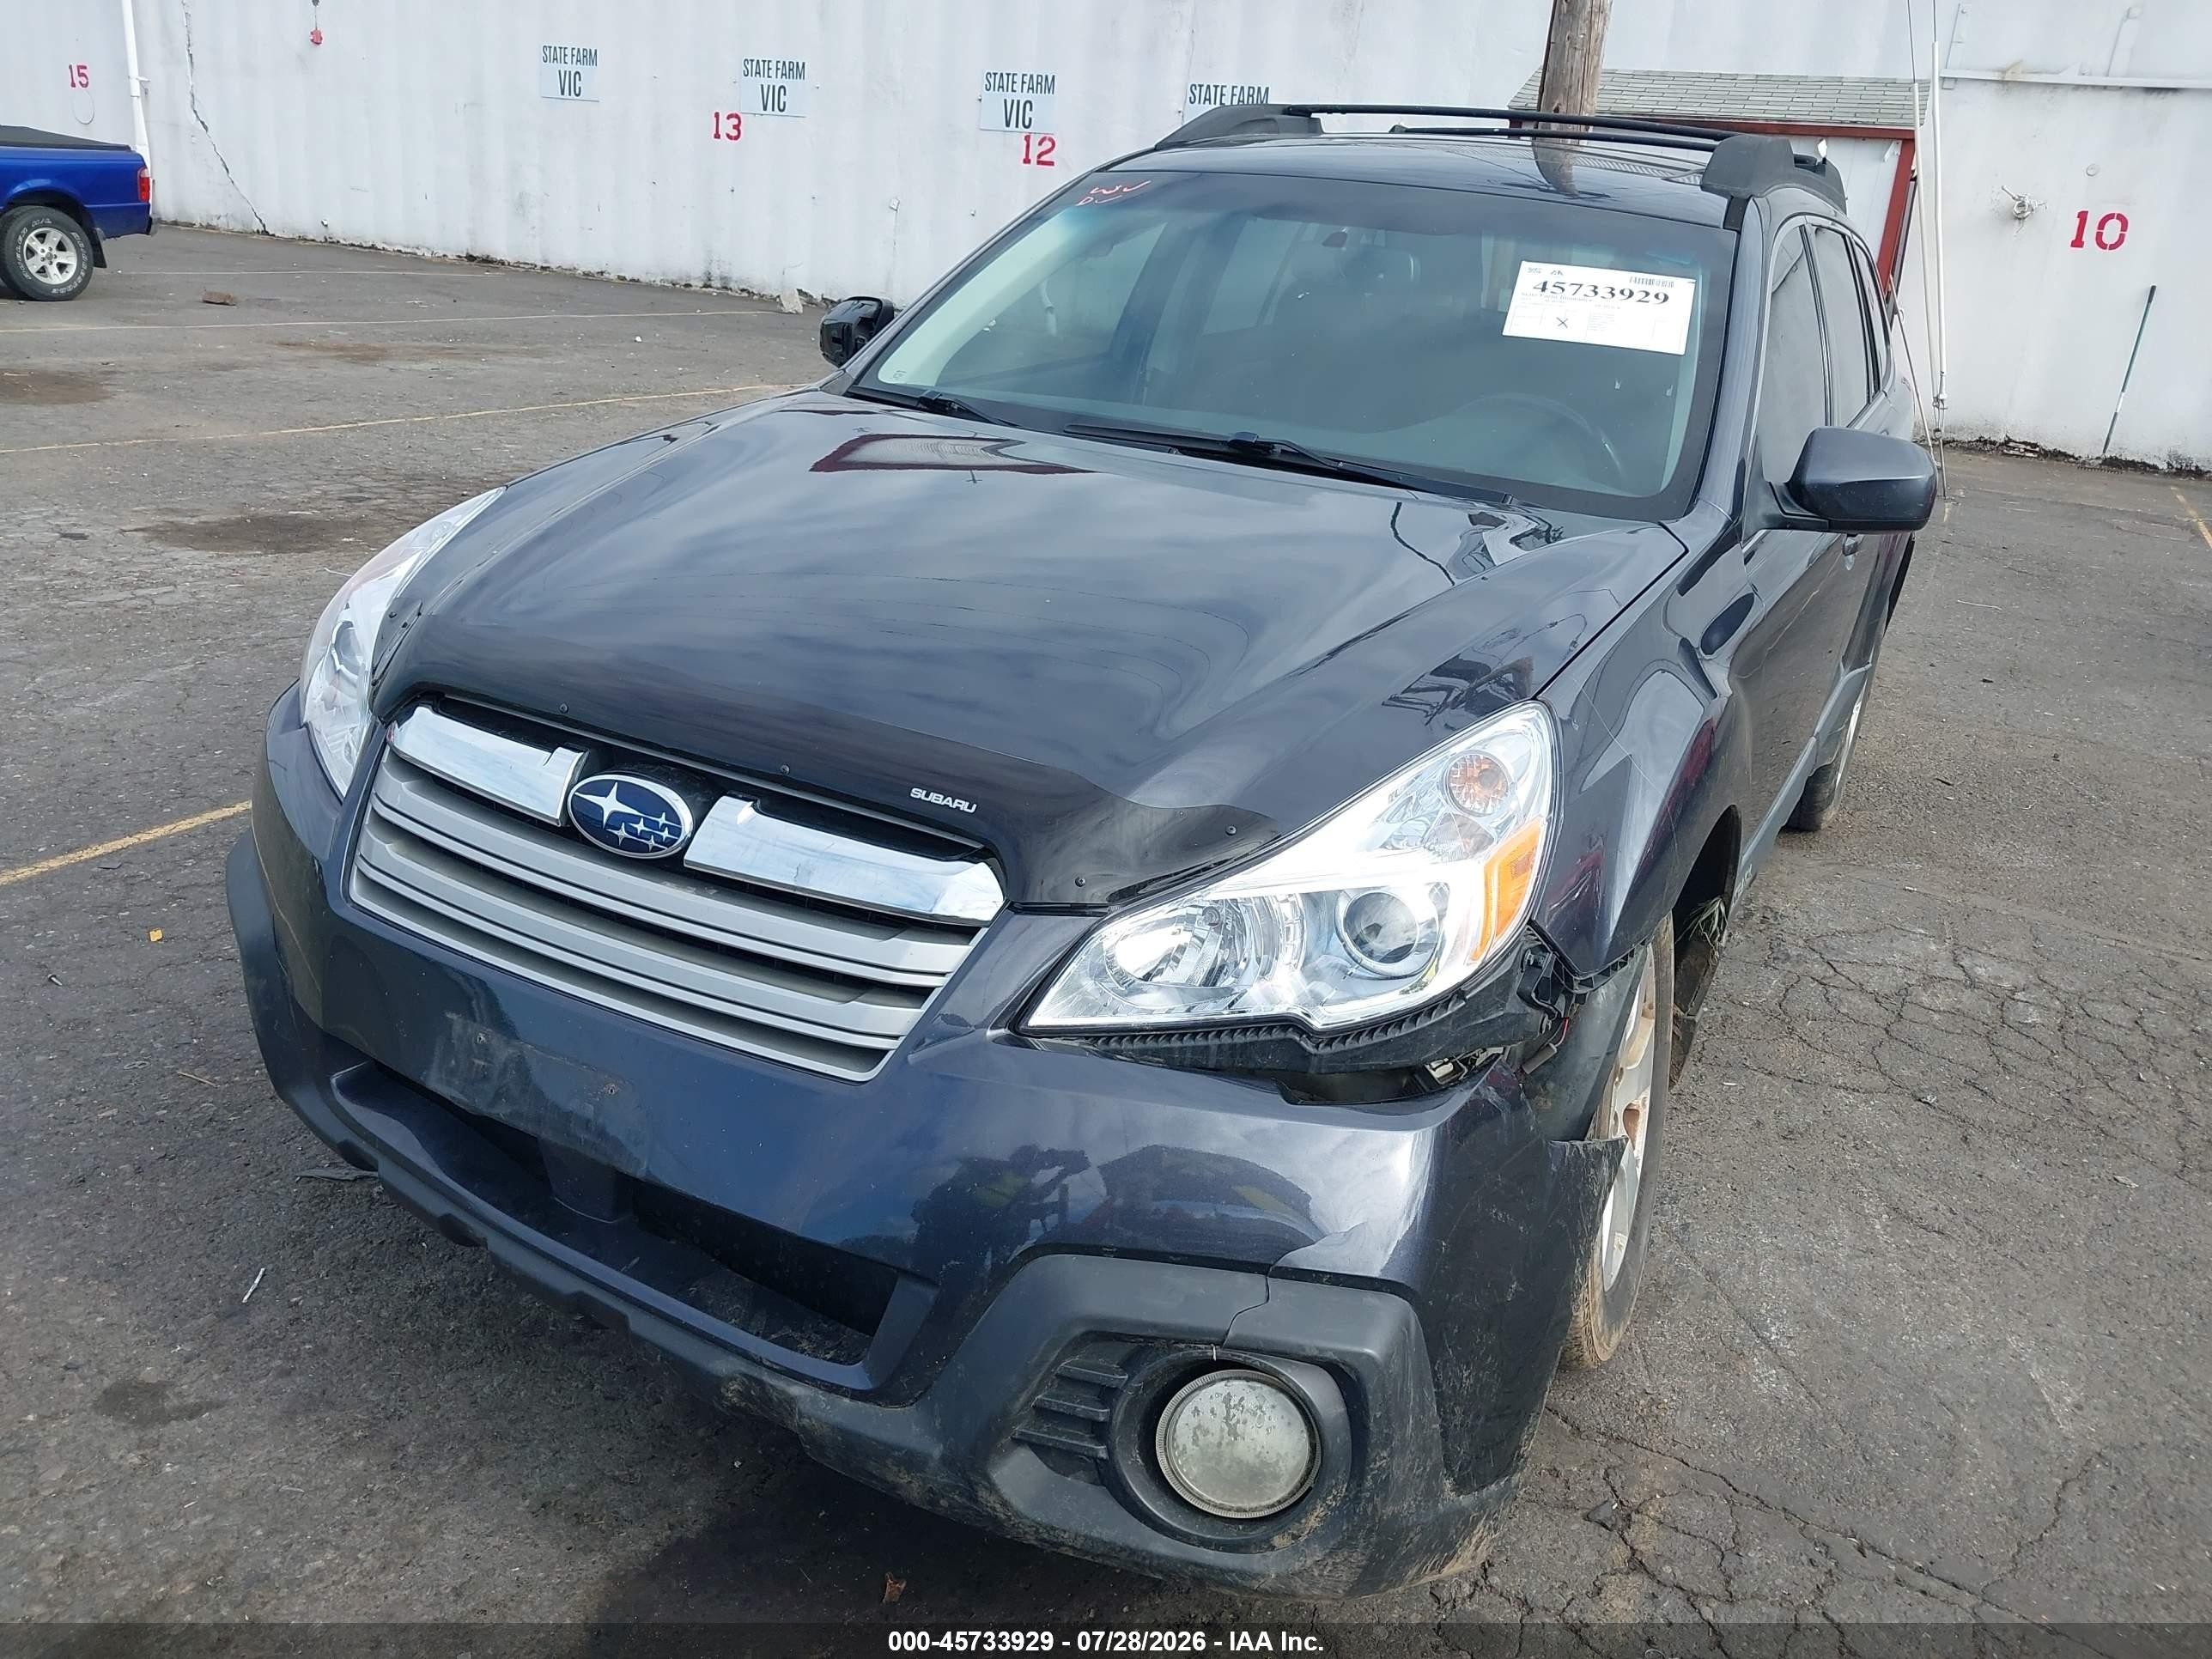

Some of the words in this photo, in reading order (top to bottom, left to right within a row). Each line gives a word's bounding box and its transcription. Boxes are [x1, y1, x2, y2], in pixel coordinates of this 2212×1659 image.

[542, 45, 568, 64] STATE
[571, 46, 599, 67] FARM
[743, 58, 773, 78] STATE
[775, 59, 806, 81] FARM
[69, 64, 88, 88] 15
[558, 70, 582, 97] VIC
[985, 70, 1018, 94] STATE
[1021, 73, 1056, 95] FARM
[760, 83, 787, 112] VIC
[1188, 83, 1227, 105] STATE
[1230, 85, 1270, 106] FARM
[713, 111, 743, 141] 13
[1003, 98, 1034, 130] VIC
[1022, 134, 1057, 167] 12
[2070, 210, 2129, 251] 10
[1533, 280, 1670, 305] 45733929
[910, 787, 978, 814] SUBARU
